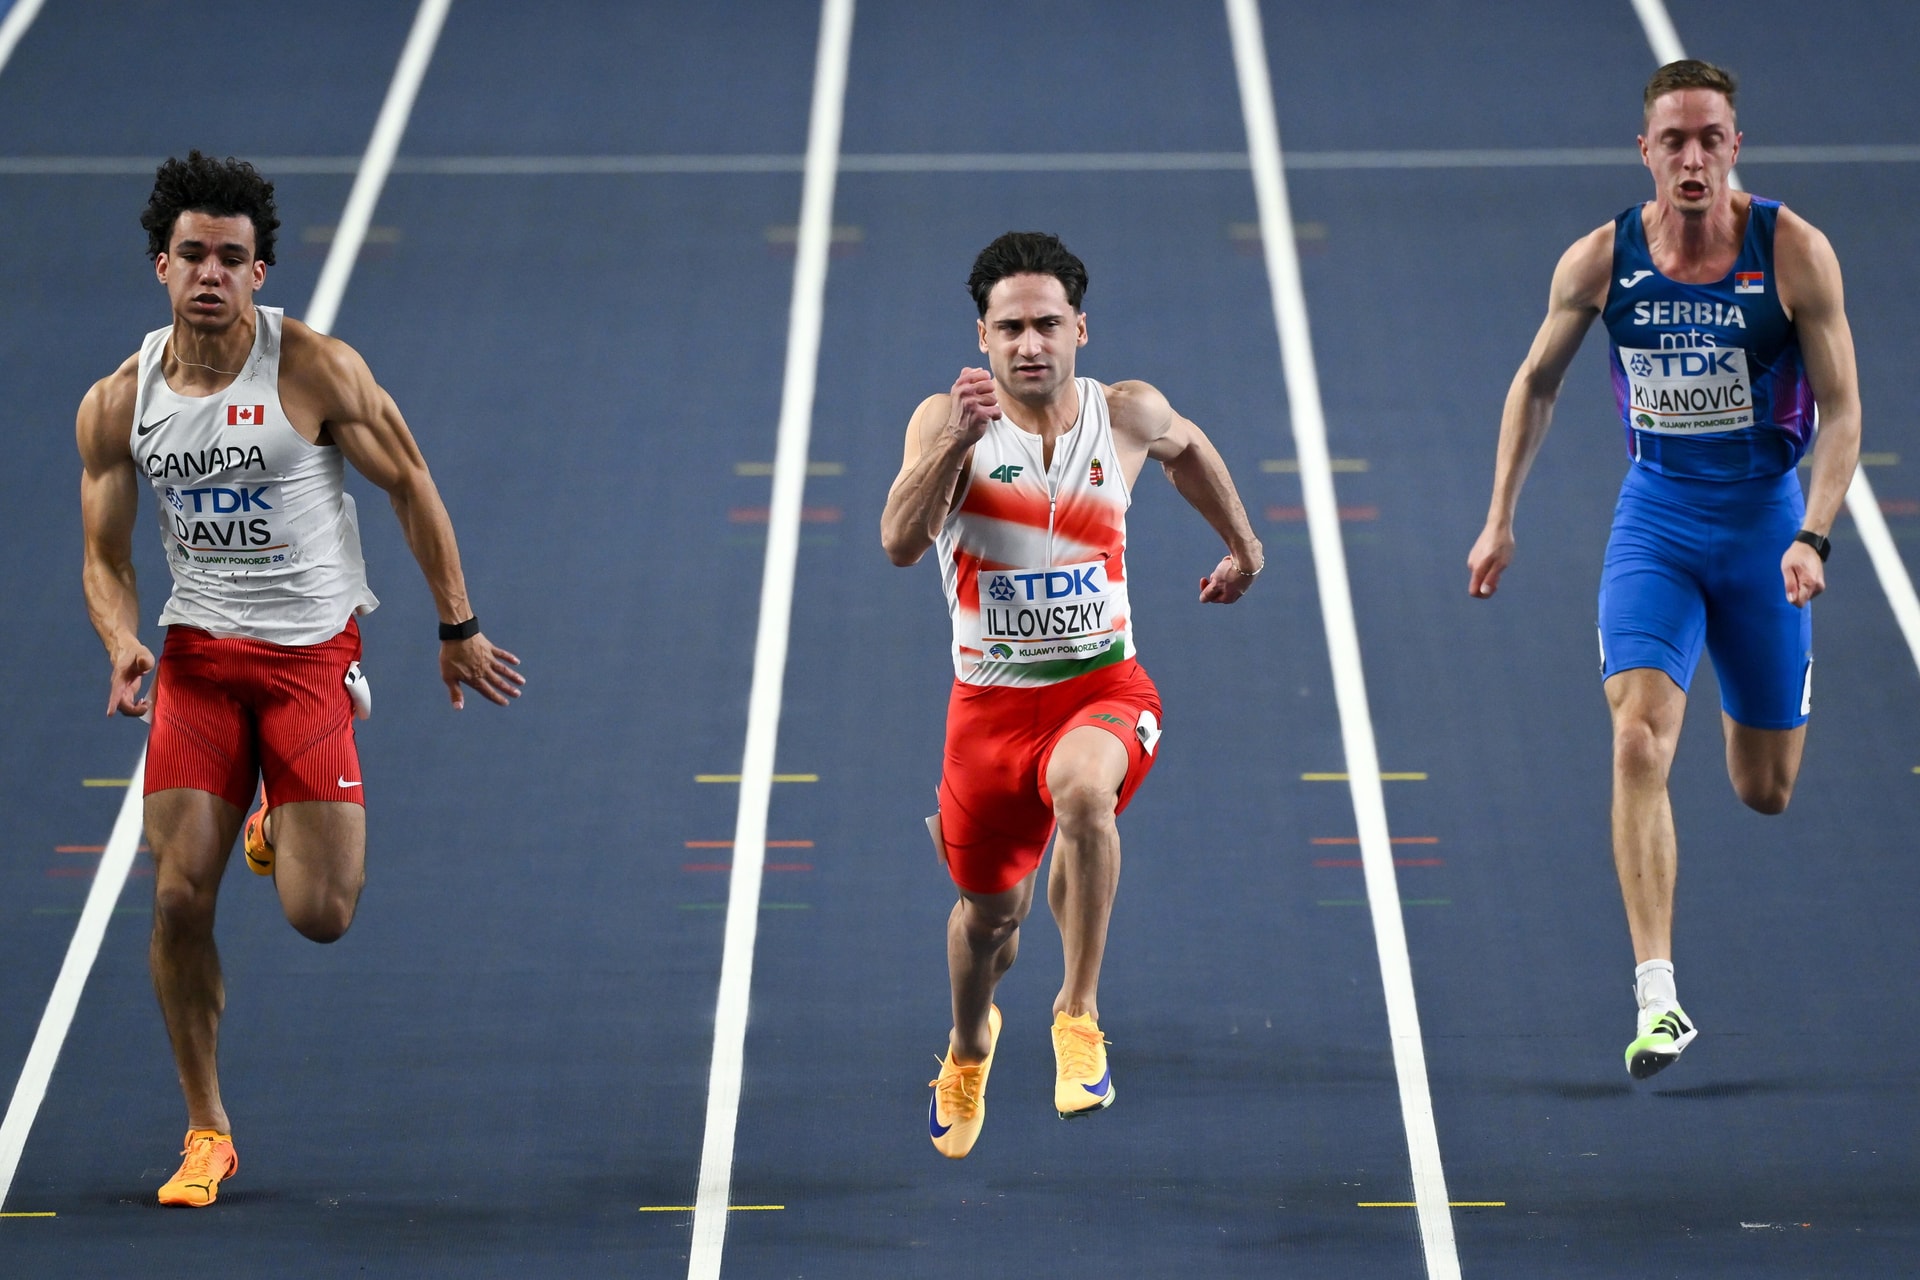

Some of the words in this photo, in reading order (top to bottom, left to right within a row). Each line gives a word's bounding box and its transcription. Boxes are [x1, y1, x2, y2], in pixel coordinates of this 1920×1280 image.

[1634, 301, 1746, 329] SERBIA
[1660, 329, 1716, 350] mts
[1651, 351, 1738, 376] TDK
[1634, 379, 1745, 411] KIJANOVIĆ
[1694, 418, 1735, 428] POMORZE
[147, 446, 266, 478] CANADA
[181, 486, 273, 513] TDK
[175, 515, 271, 546] DAVIS
[194, 555, 228, 564] KUJAWY
[229, 556, 271, 565] POMORZE
[1014, 567, 1100, 601] TDK
[987, 601, 1105, 636] ILLOVSZKY
[1019, 646, 1055, 657] KUJAWY
[1057, 642, 1098, 654] POMORZE
